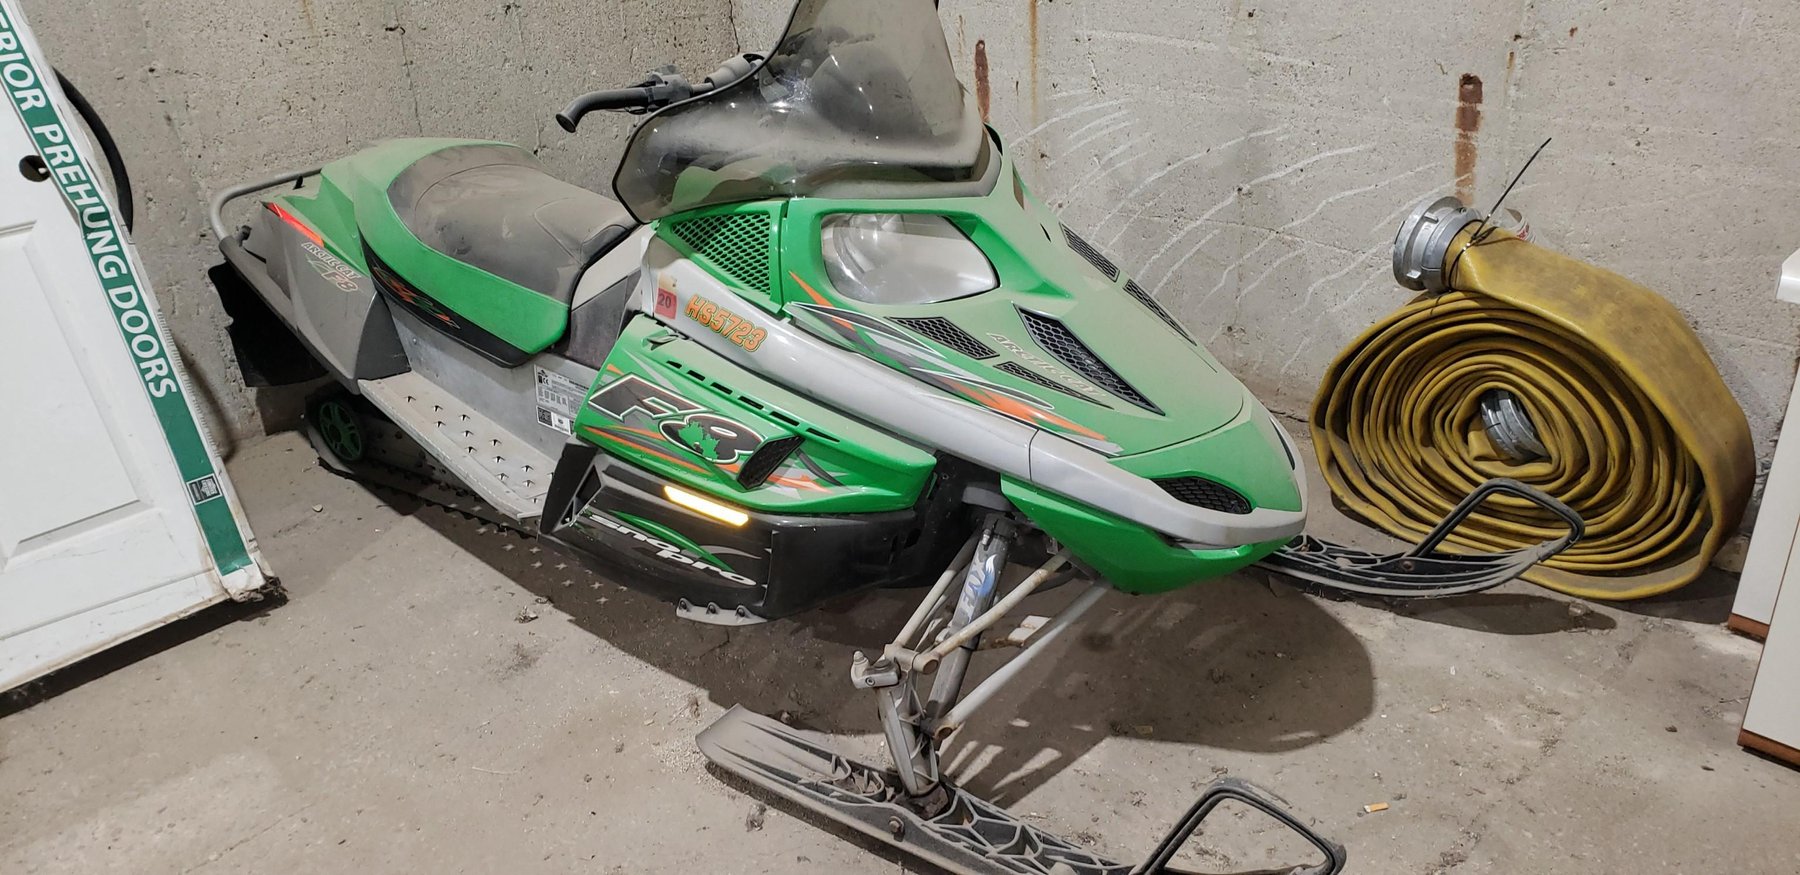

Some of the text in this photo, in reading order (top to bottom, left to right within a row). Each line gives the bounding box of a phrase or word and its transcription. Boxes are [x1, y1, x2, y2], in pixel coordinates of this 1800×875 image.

[32, 124, 129, 279] PREHUNG
[108, 284, 177, 398] DOORS
[301, 242, 361, 279] ARCTIC CAT
[321, 270, 358, 292] F8
[659, 293, 671, 308] 20
[588, 372, 768, 464] F8
